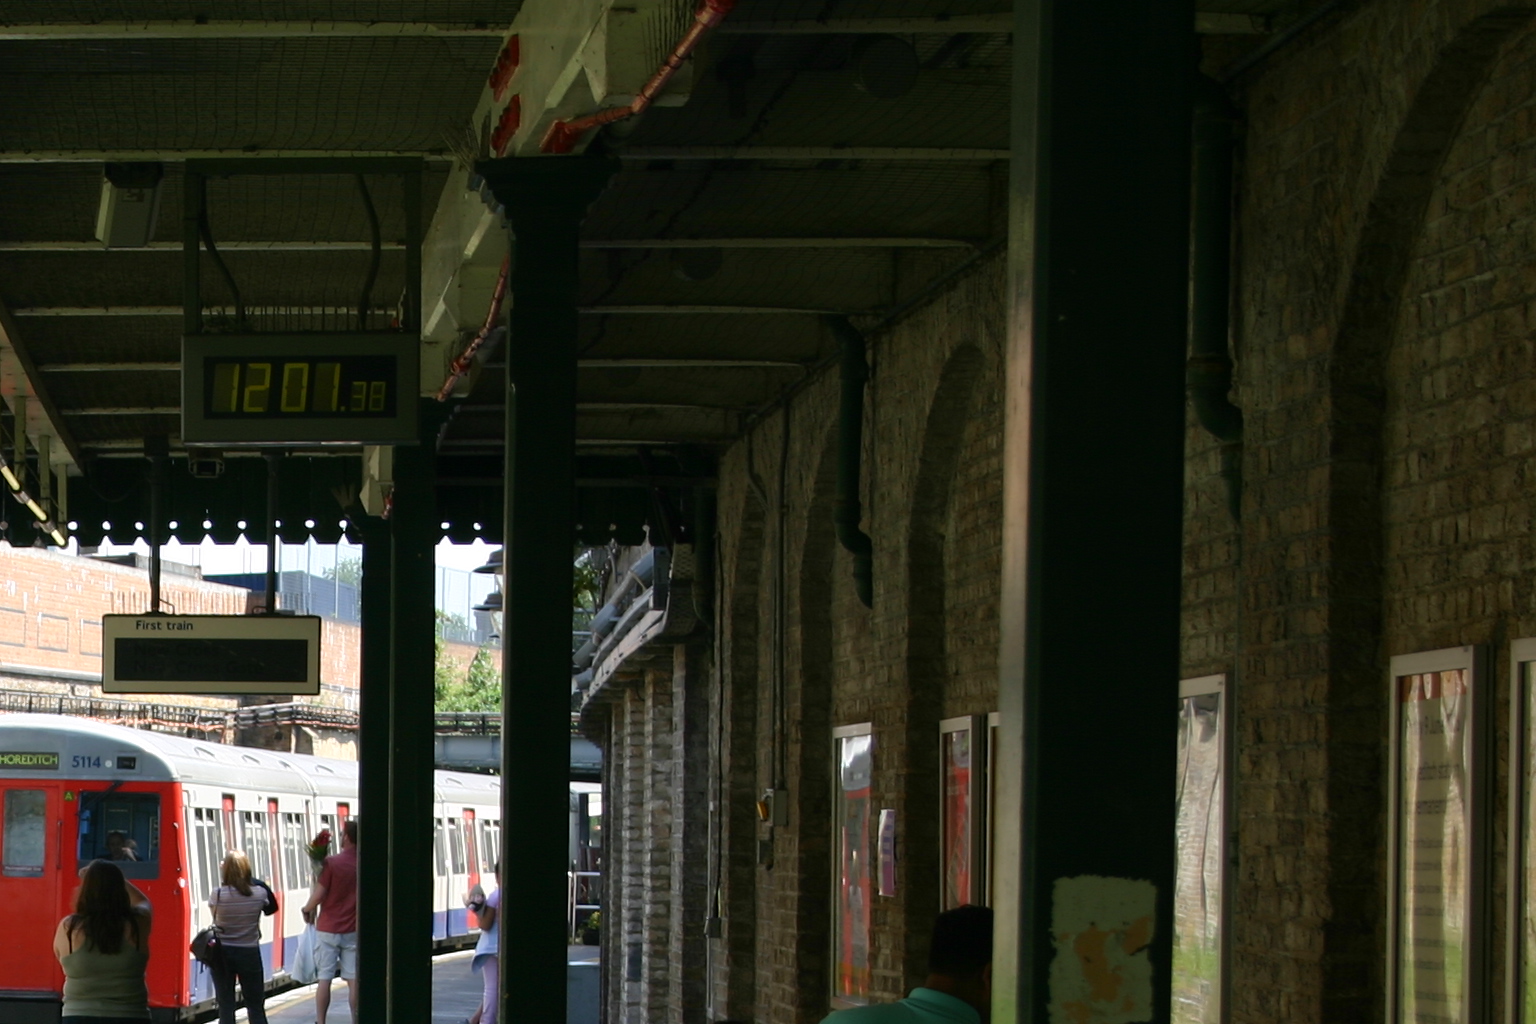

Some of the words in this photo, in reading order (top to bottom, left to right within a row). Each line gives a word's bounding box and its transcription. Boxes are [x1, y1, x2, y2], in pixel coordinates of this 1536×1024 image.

[136, 620, 162, 630] First
[166, 620, 194, 630] train
[71, 755, 101, 768] 5114
[64, 791, 73, 800] A
